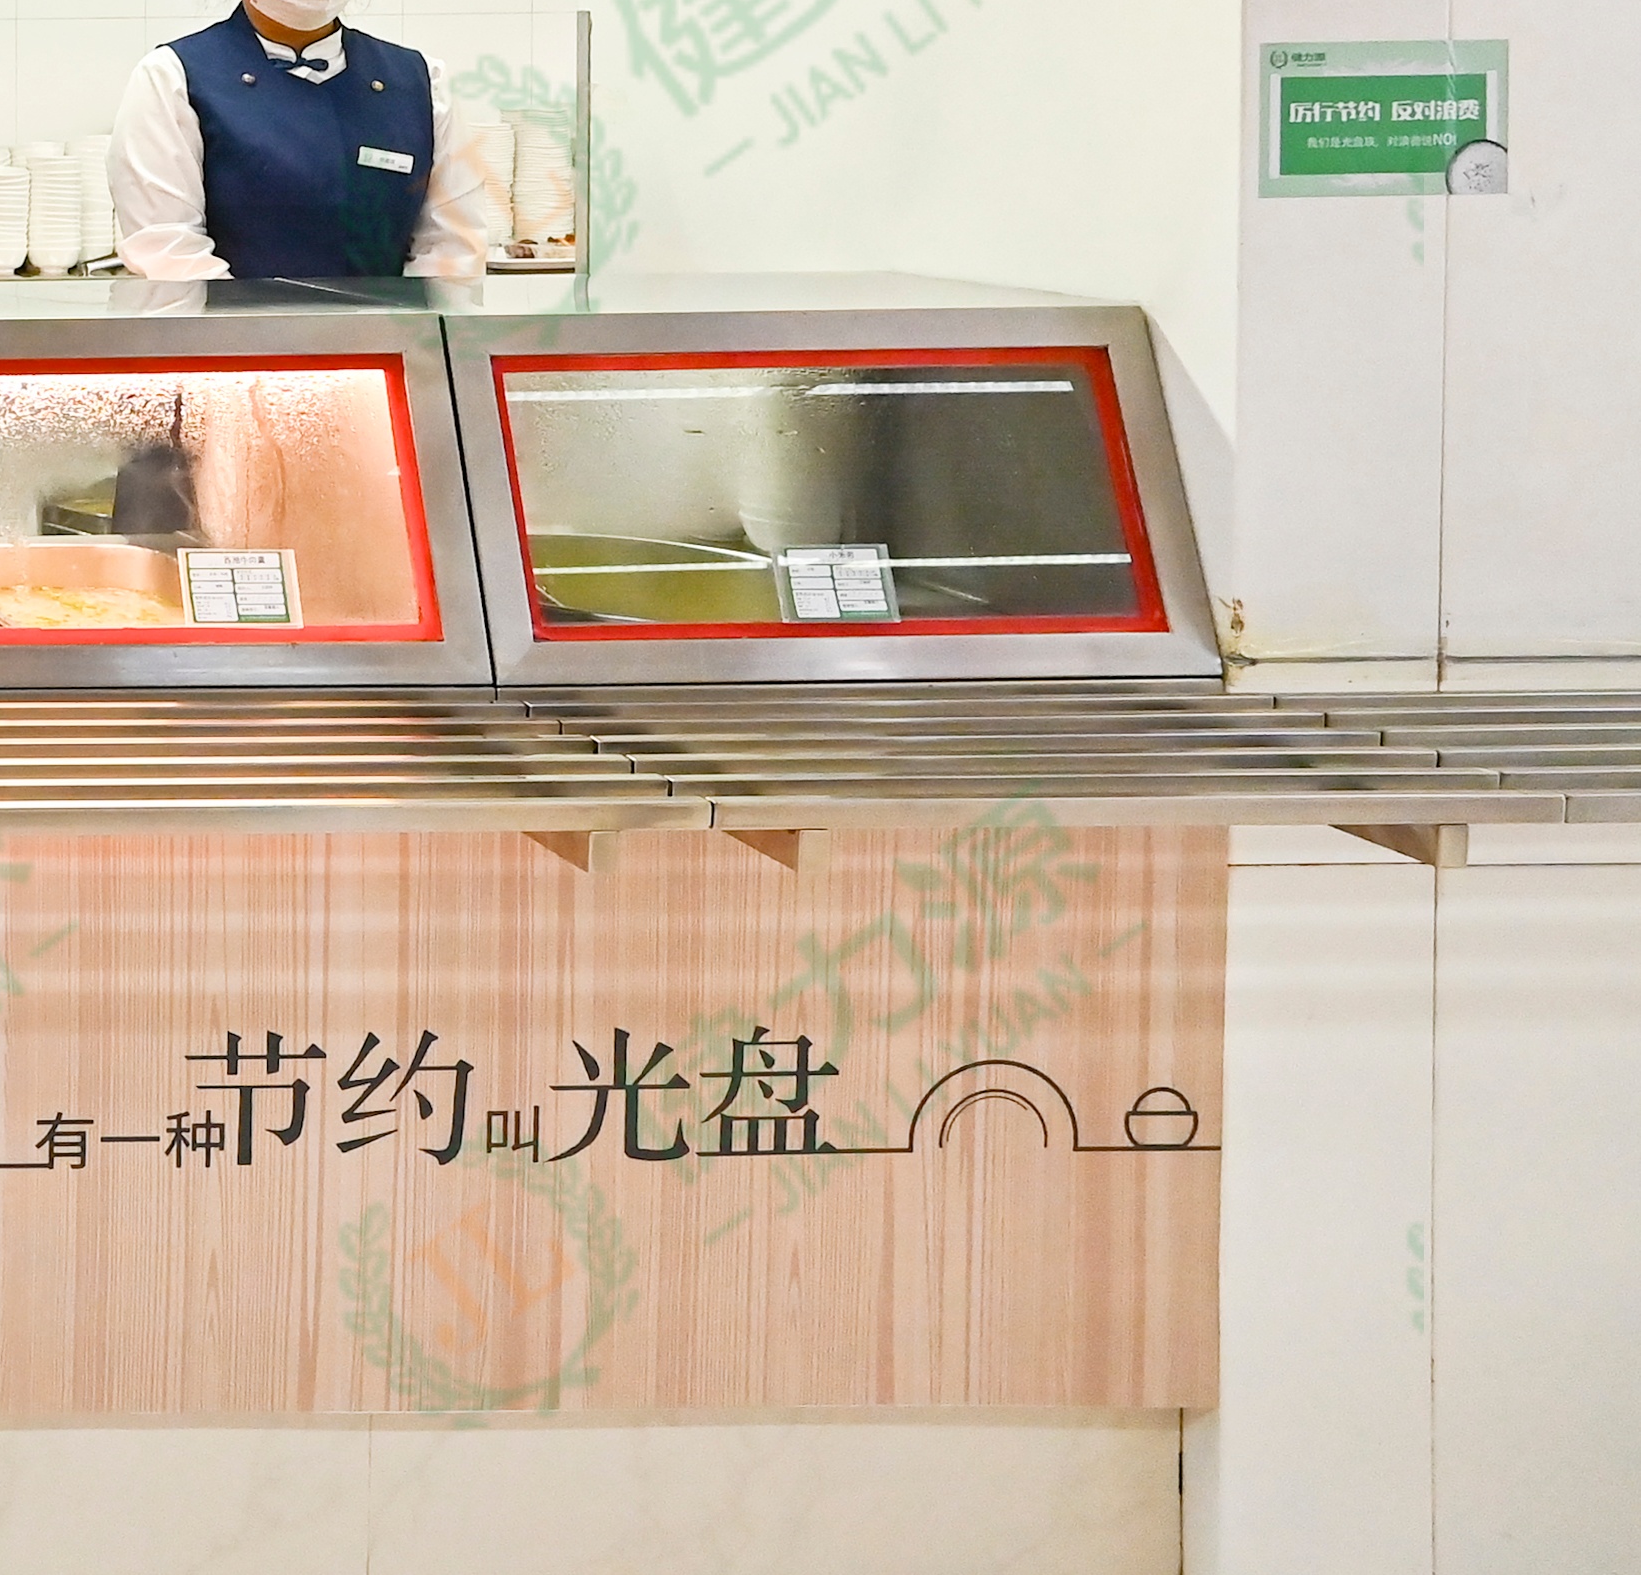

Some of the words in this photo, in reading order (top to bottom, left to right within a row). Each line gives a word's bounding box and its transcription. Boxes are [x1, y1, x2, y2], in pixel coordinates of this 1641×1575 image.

[1289, 101, 1381, 123] 厉行节约
[1390, 99, 1481, 121] 反对浪费
[36, 1025, 841, 1169] 有一种节约叫光盘
